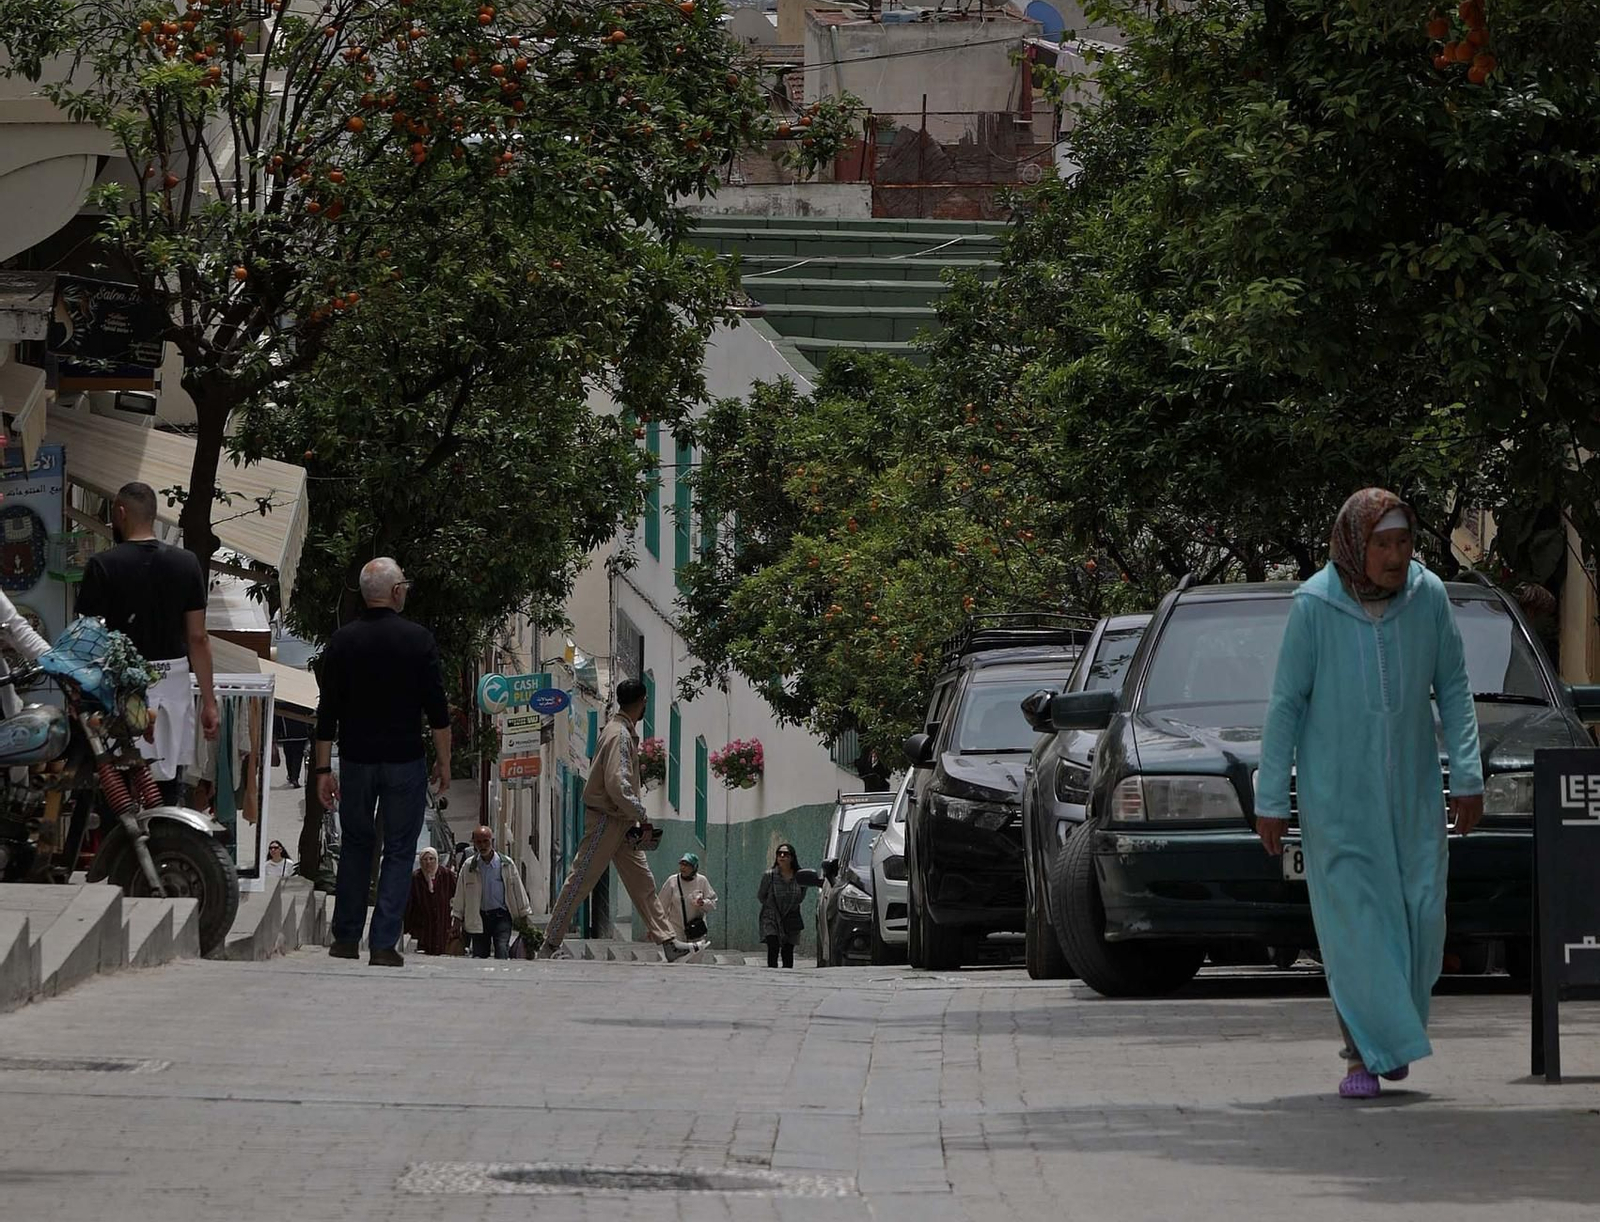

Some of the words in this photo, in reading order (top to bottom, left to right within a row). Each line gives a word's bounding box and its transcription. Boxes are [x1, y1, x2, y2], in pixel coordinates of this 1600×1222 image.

[514, 679, 539, 690] CASH
[514, 690, 537, 702] PLU
[508, 763, 523, 776] ria
[1294, 850, 1304, 874] 8
